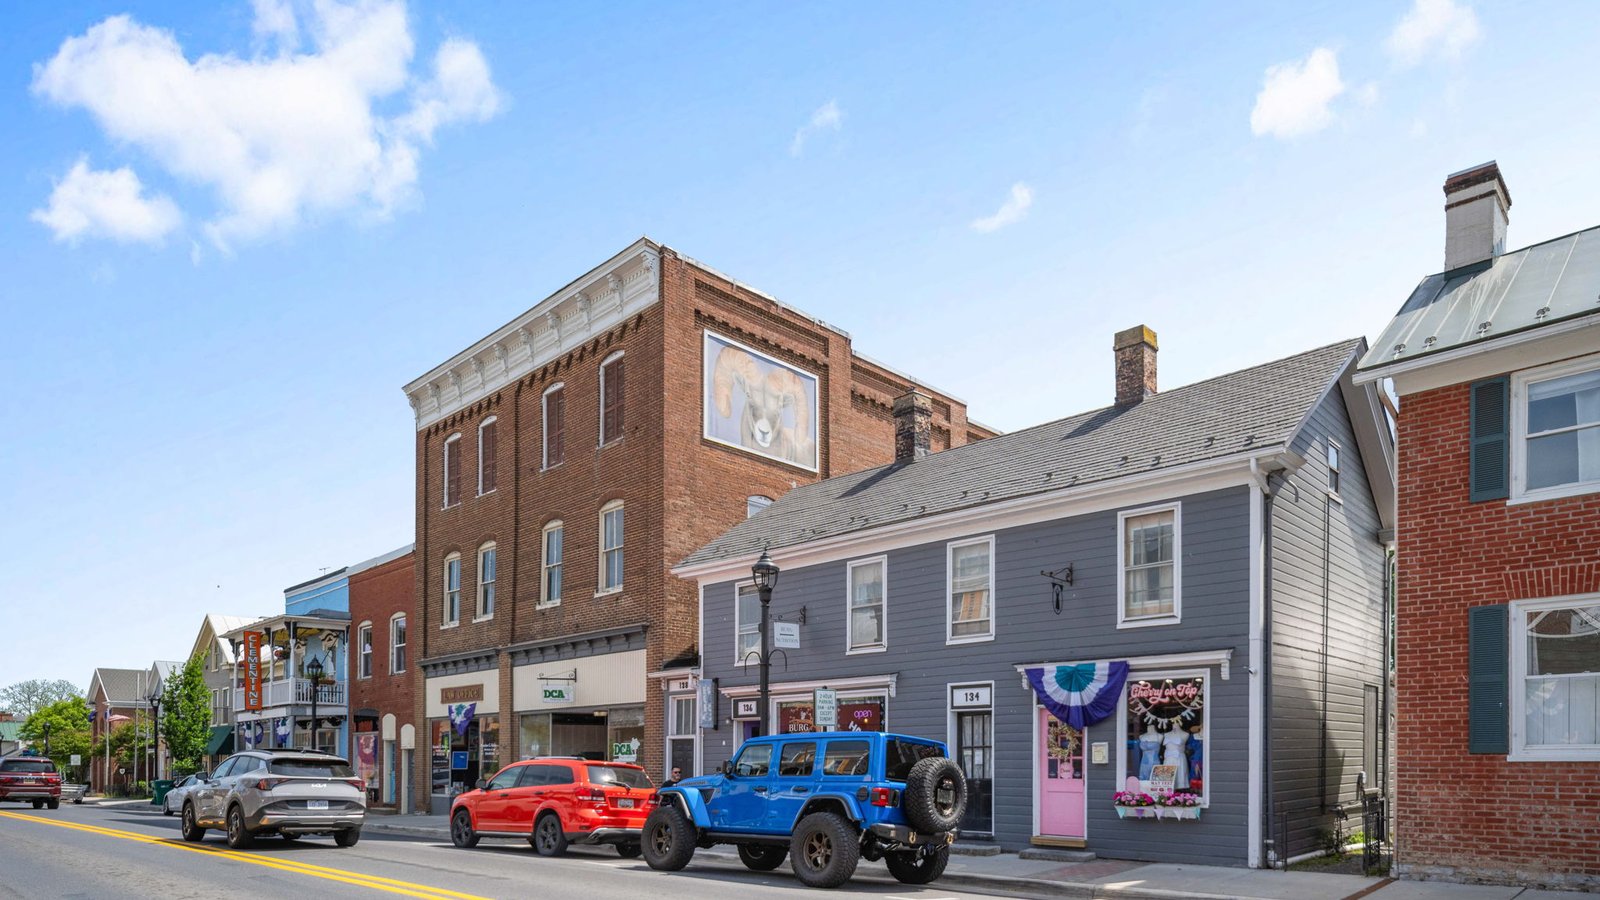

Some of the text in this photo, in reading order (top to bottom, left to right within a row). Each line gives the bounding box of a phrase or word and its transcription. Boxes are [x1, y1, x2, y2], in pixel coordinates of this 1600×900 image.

[248, 634, 259, 706] CLEMENTINE
[458, 687, 481, 699] OFFICE
[543, 689, 565, 699] DCA
[964, 691, 980, 702] 134
[1130, 682, 1198, 704] Cherry on Top
[743, 704, 753, 712] 136
[854, 710, 872, 719] open
[614, 743, 633, 756] DCA
